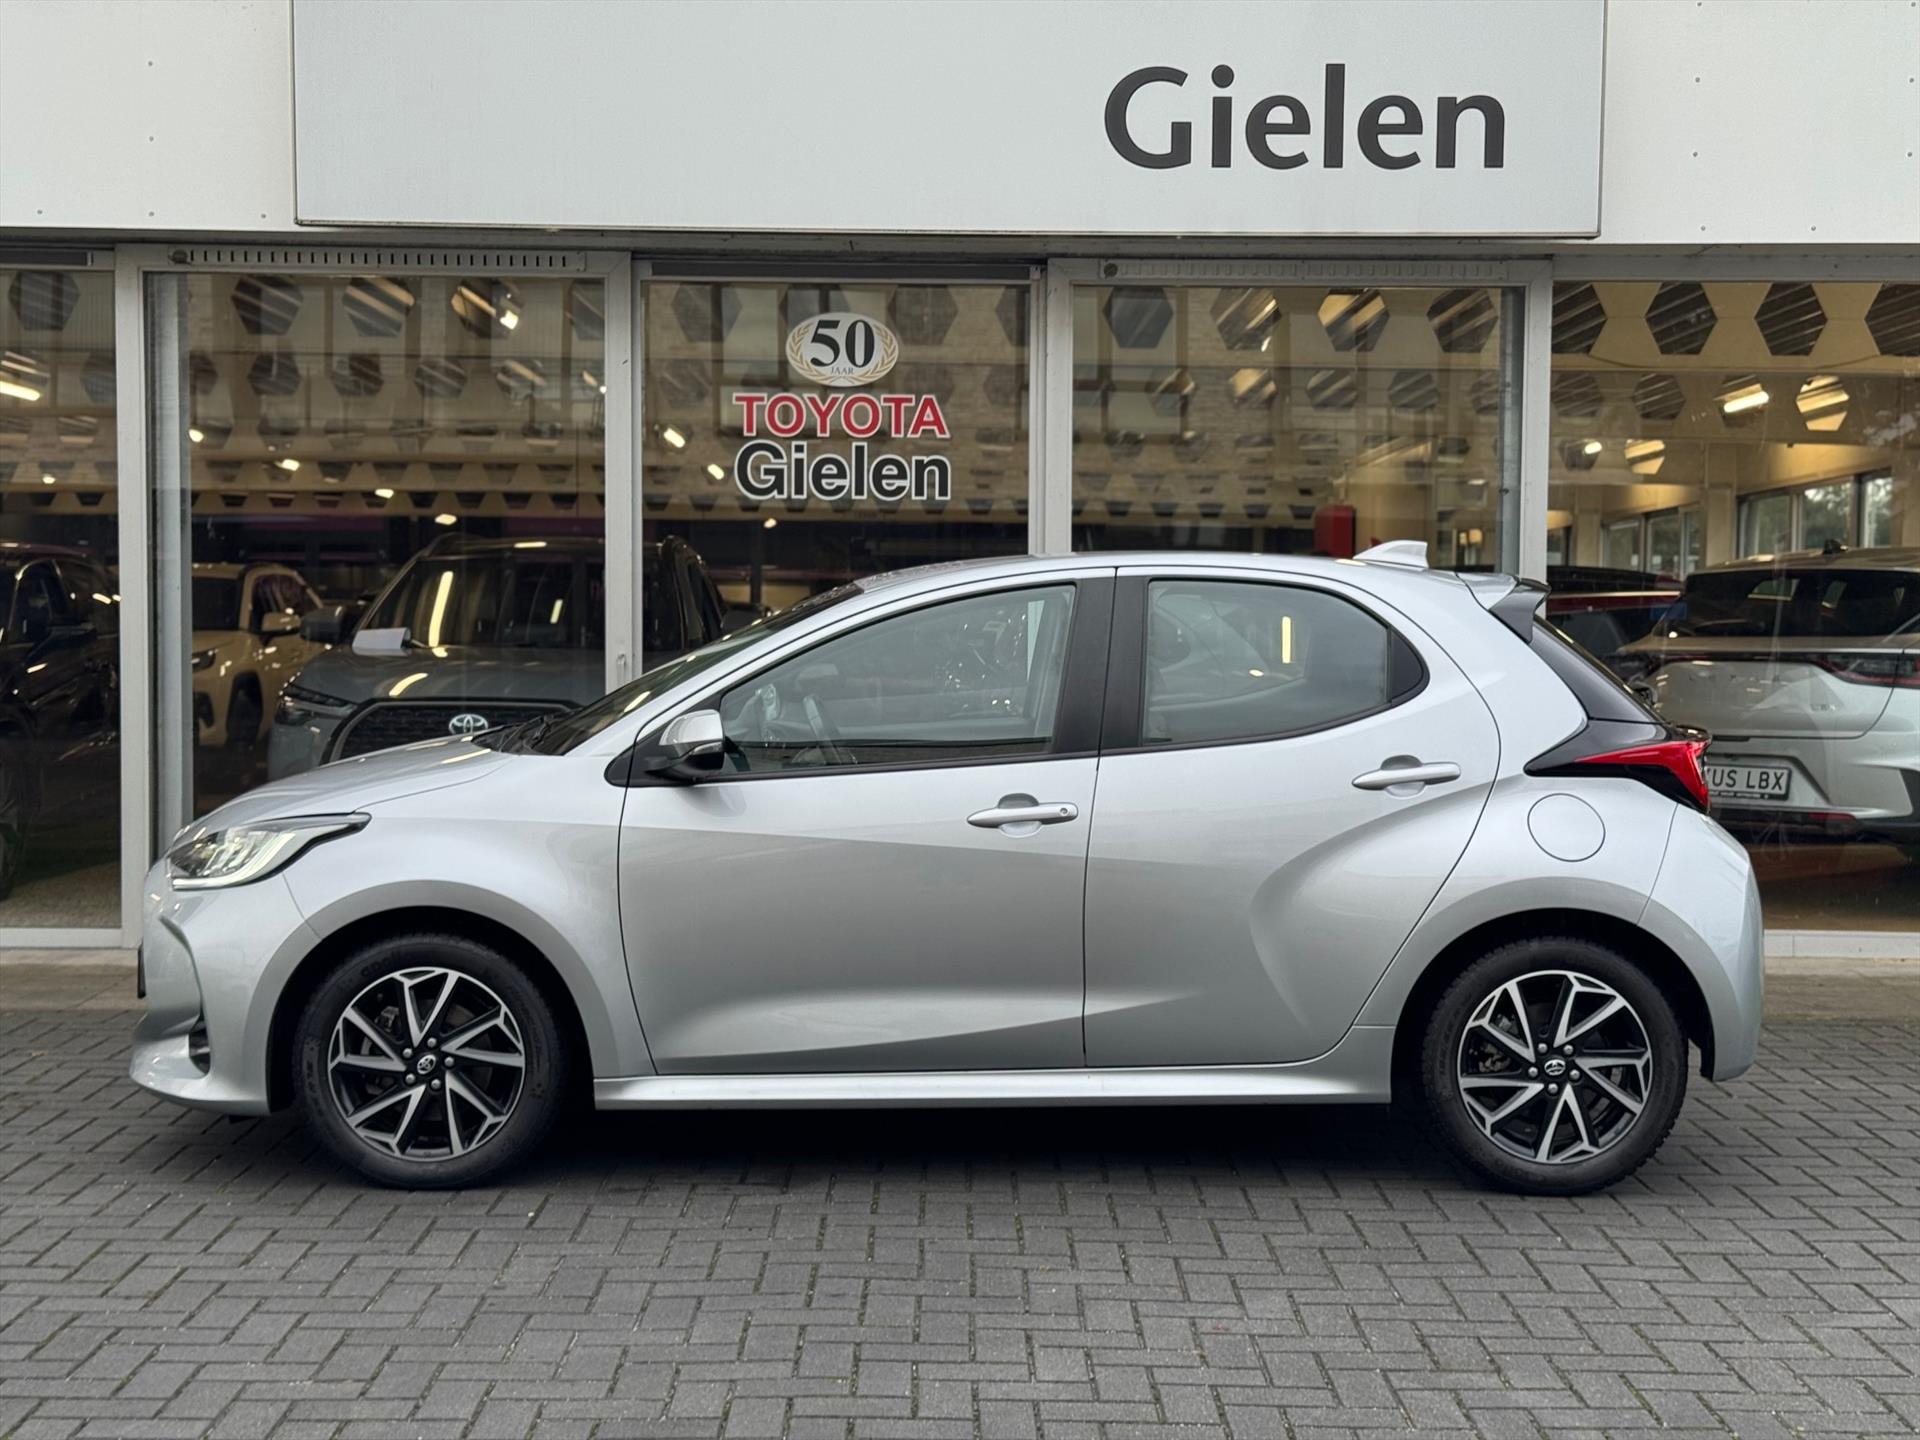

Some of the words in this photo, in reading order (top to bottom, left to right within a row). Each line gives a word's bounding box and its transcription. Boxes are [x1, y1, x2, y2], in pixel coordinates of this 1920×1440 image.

[1105, 63, 1505, 170] Gielen
[810, 319, 874, 367] 50
[830, 366, 854, 375] JAAR
[733, 393, 950, 438] TOYOTA
[735, 440, 951, 500] Gielen
[1746, 770, 1785, 791] LBX
